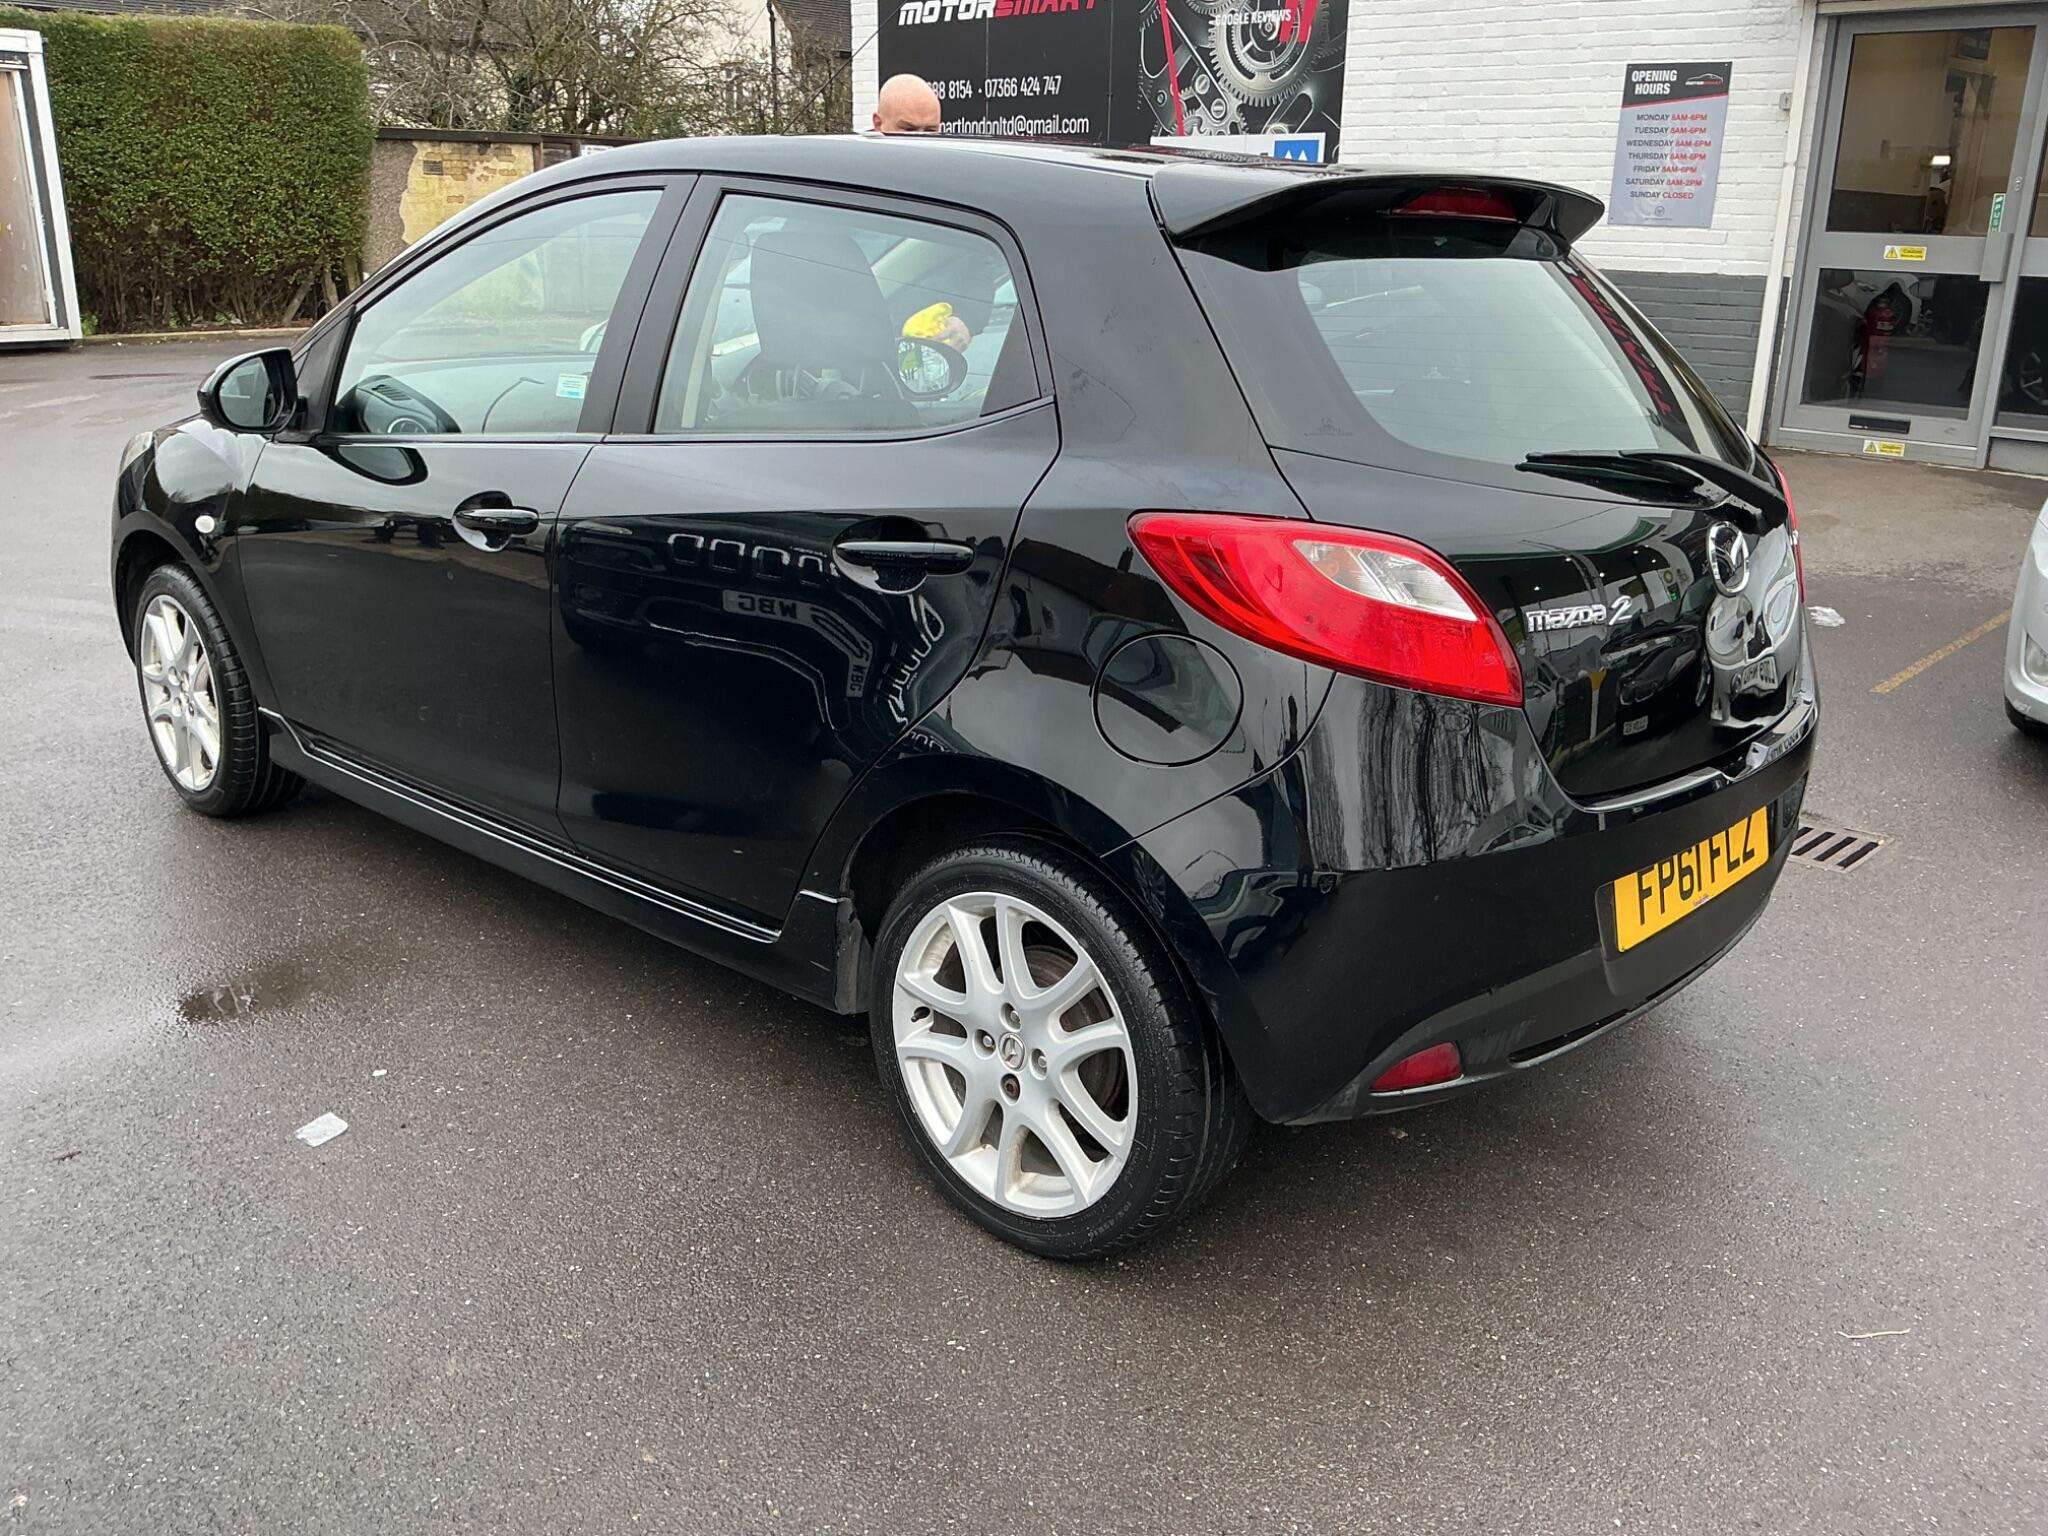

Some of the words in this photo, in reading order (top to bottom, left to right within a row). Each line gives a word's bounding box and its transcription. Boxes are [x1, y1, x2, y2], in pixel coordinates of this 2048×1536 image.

[1215, 12, 1250, 26] GOOGLE
[1251, 8, 1292, 24] REVIEWS
[1632, 70, 1678, 82] OPENING
[948, 79, 973, 99] 8154
[984, 77, 1018, 98] 07366
[1020, 76, 1041, 97] 424
[1043, 75, 1062, 96] 747
[1634, 82, 1671, 95] HOURS
[1636, 113, 1670, 121] MONDAY
[1634, 126, 1669, 134] TUESDAY
[1626, 139, 1673, 147] WEDNESDAY
[1628, 152, 1668, 160] THURSDAY
[1633, 165, 1660, 173] FRIDAY
[1630, 190, 1661, 198] SUNDAY
[1662, 191, 1694, 199] CLOSED
[1608, 595, 1633, 626] 2
